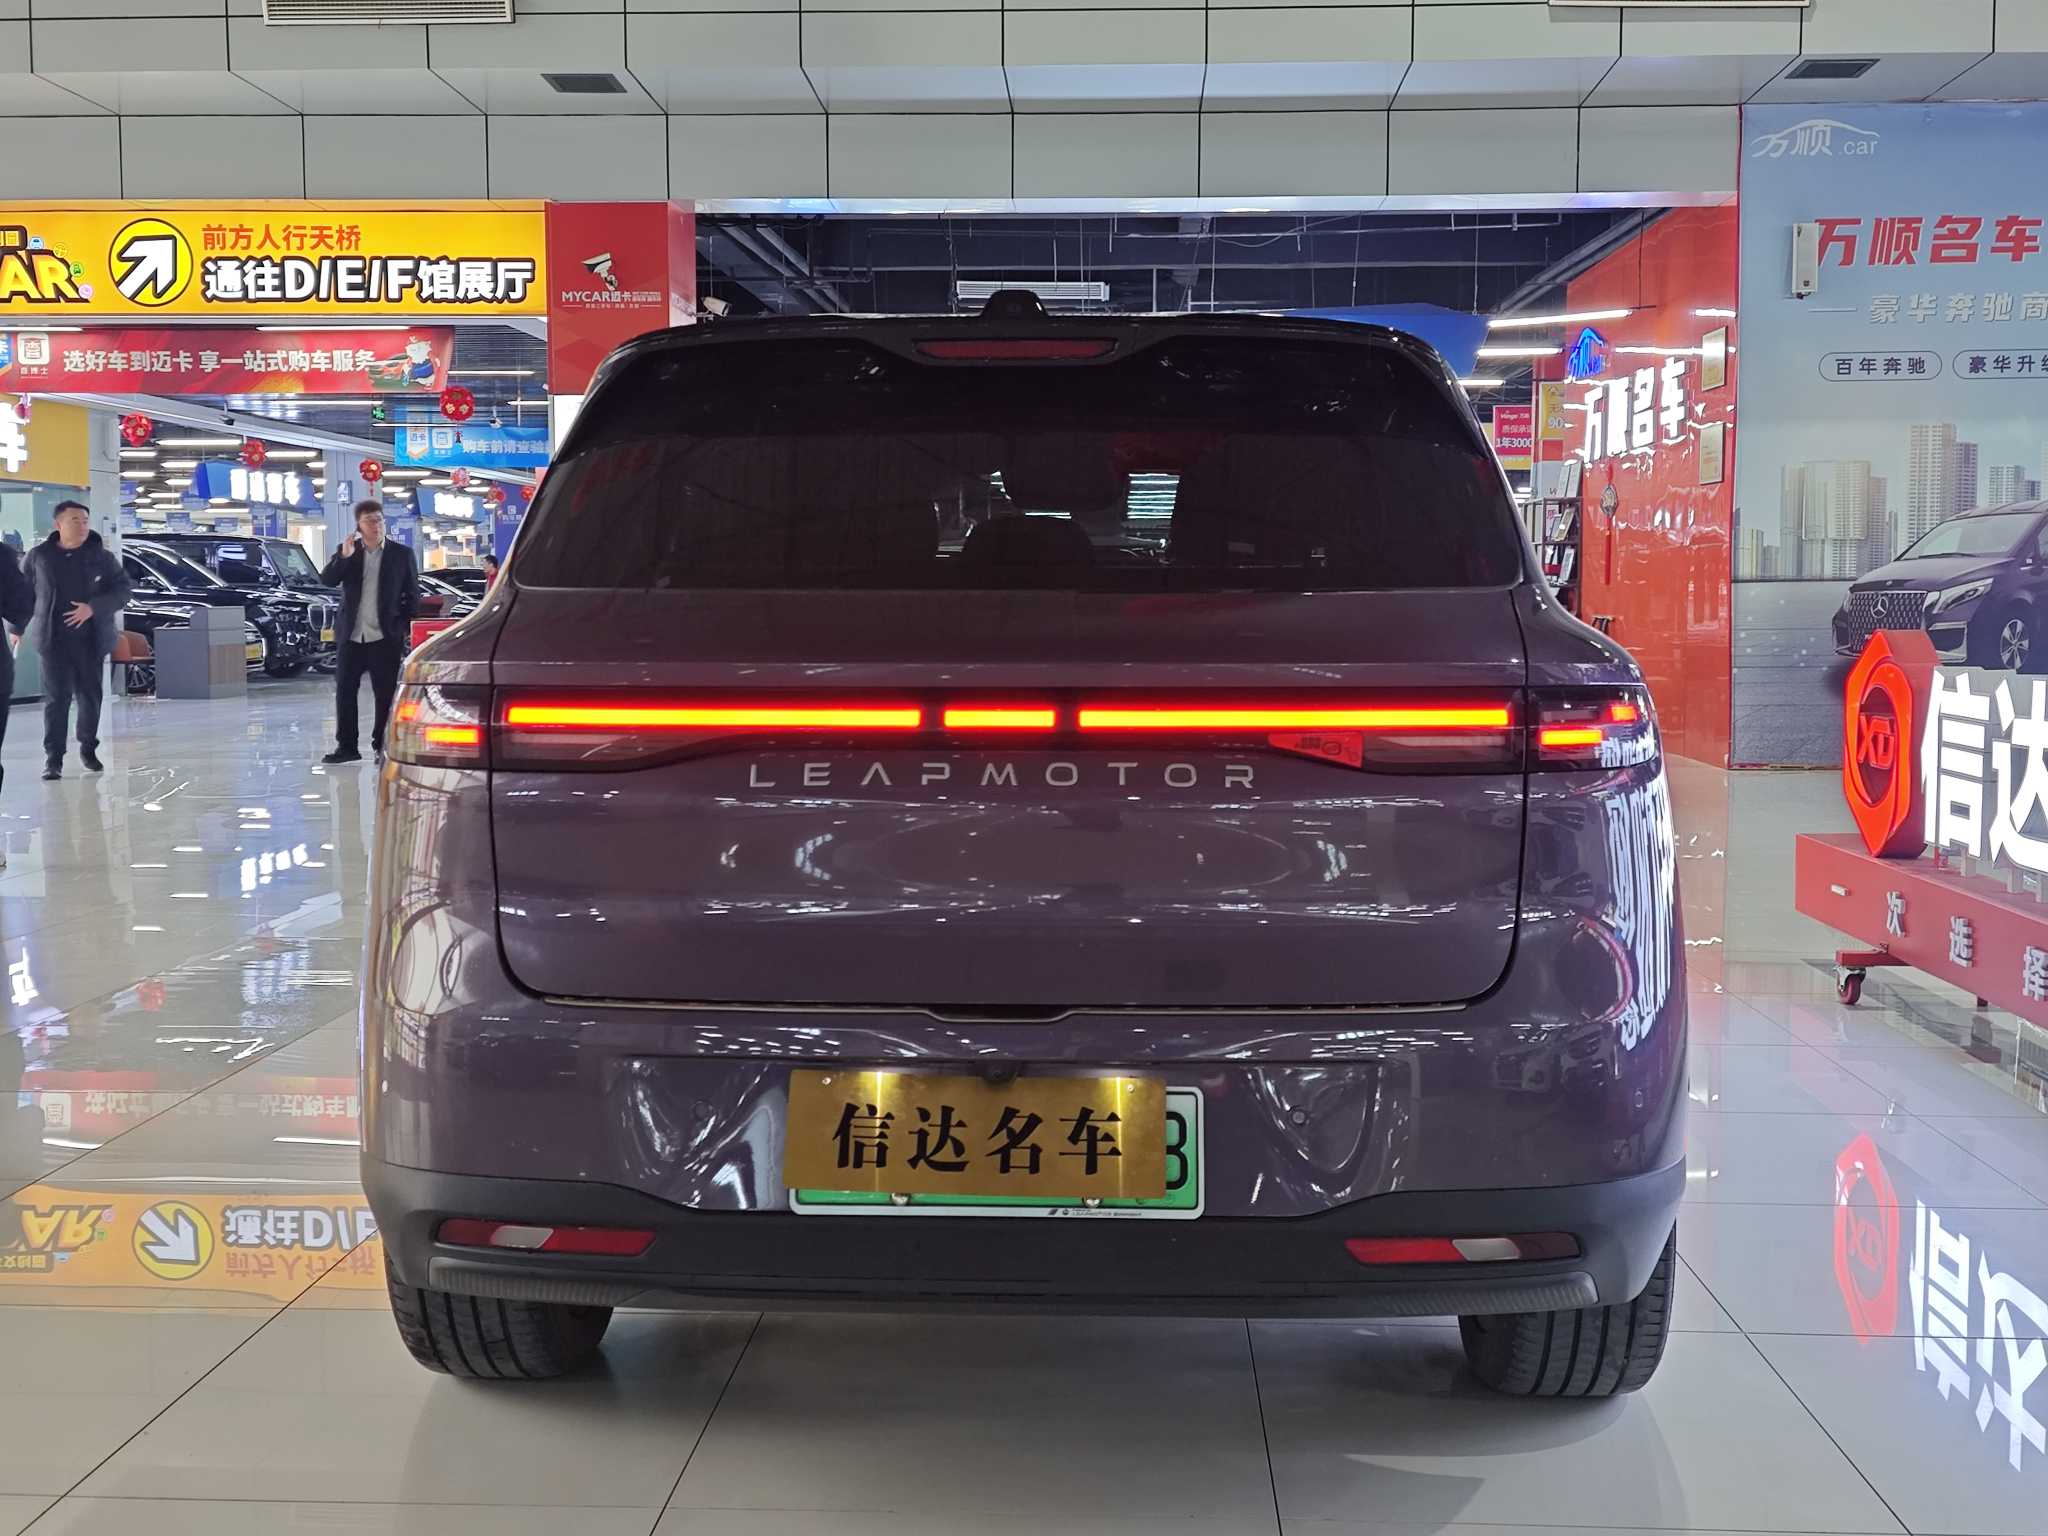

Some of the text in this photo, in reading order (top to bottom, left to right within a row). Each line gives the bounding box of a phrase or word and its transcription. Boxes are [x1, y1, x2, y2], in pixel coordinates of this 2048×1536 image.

[202, 223, 362, 251] 前方人行天桥
[1814, 215, 2043, 267] 万顺名车
[202, 256, 534, 301] 通往D/E/F馆展厅
[63, 349, 375, 373] 选好车到迈卡 享一站式购车服务
[1835, 357, 1926, 375] 百年奔驰
[749, 762, 1254, 789] LEAPMOTOR
[832, 1102, 1123, 1176] 信达名车
